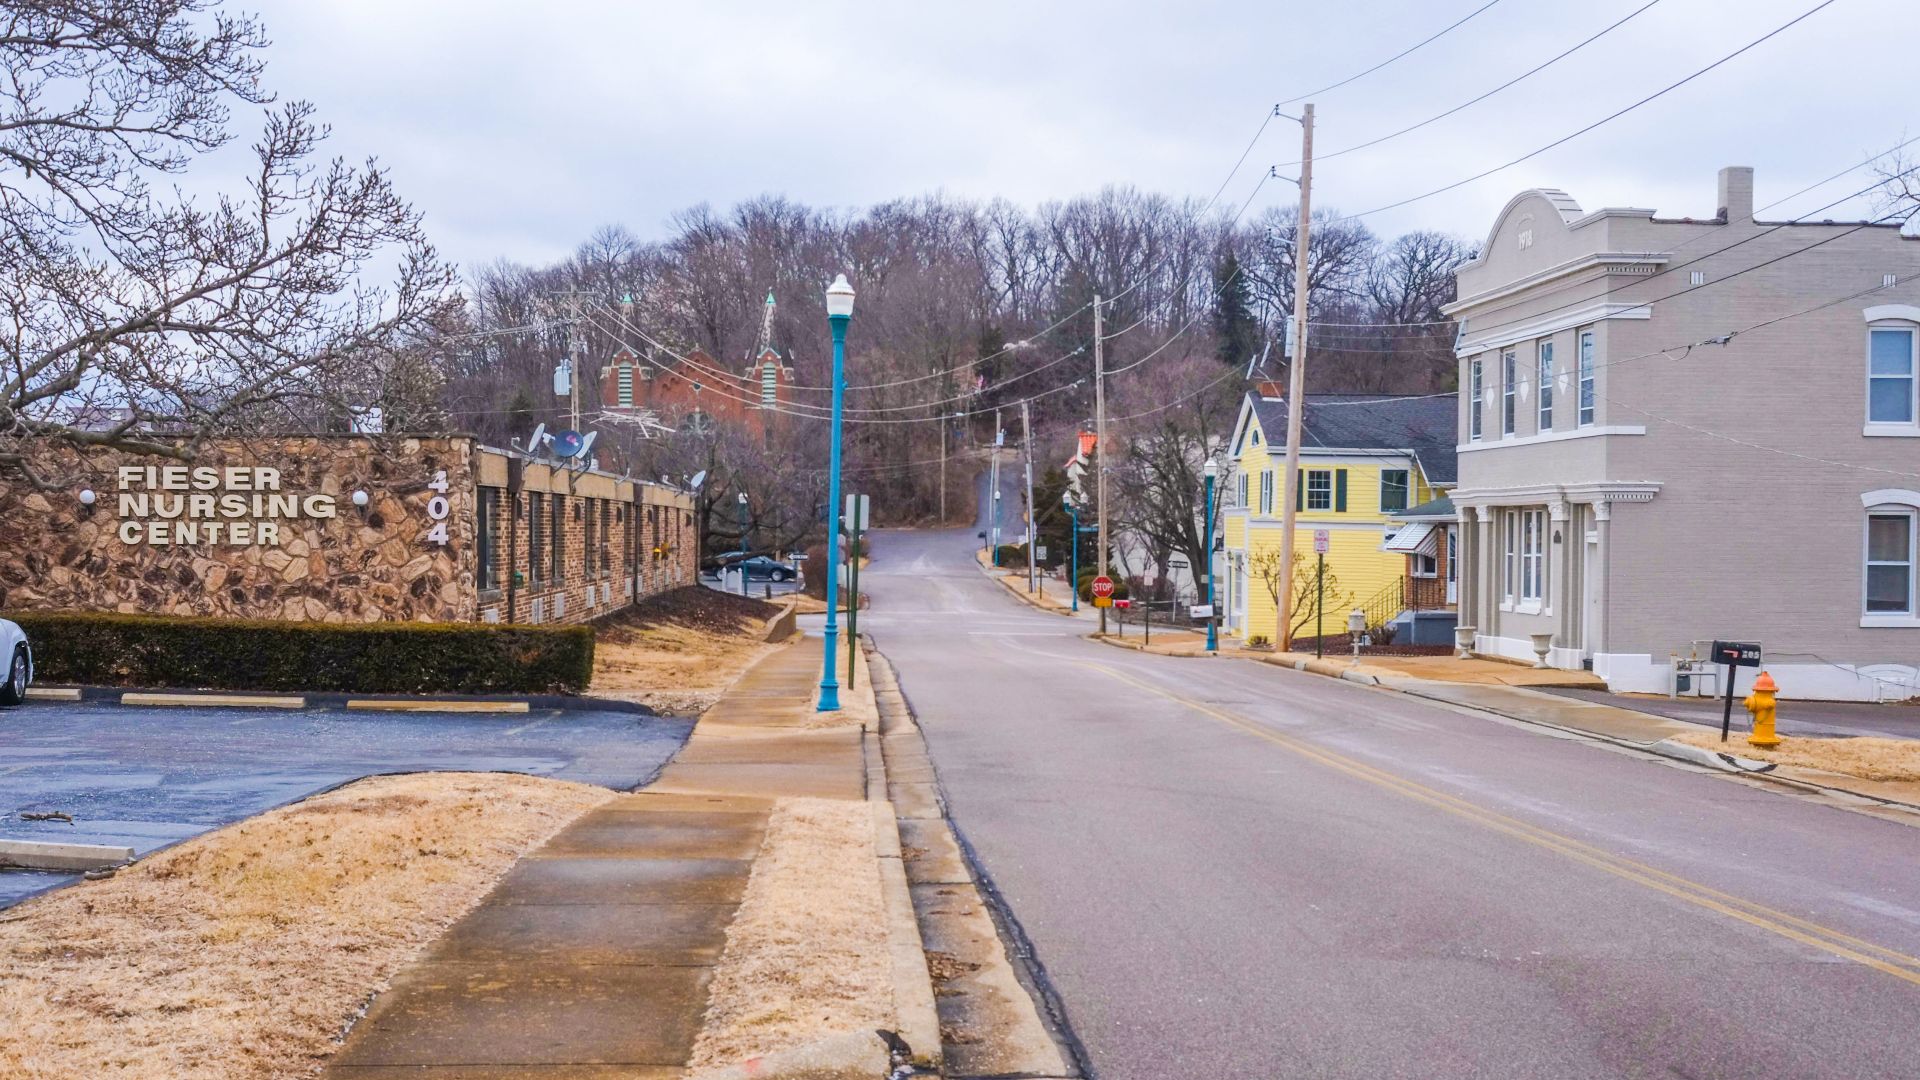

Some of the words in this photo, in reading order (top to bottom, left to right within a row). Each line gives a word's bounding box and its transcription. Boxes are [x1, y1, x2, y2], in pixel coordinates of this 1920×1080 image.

[118, 466, 281, 491] FIESER
[119, 494, 336, 518] NURSING
[428, 470, 449, 546] 404
[119, 521, 279, 545] CENTER
[1094, 582, 1112, 592] STOP
